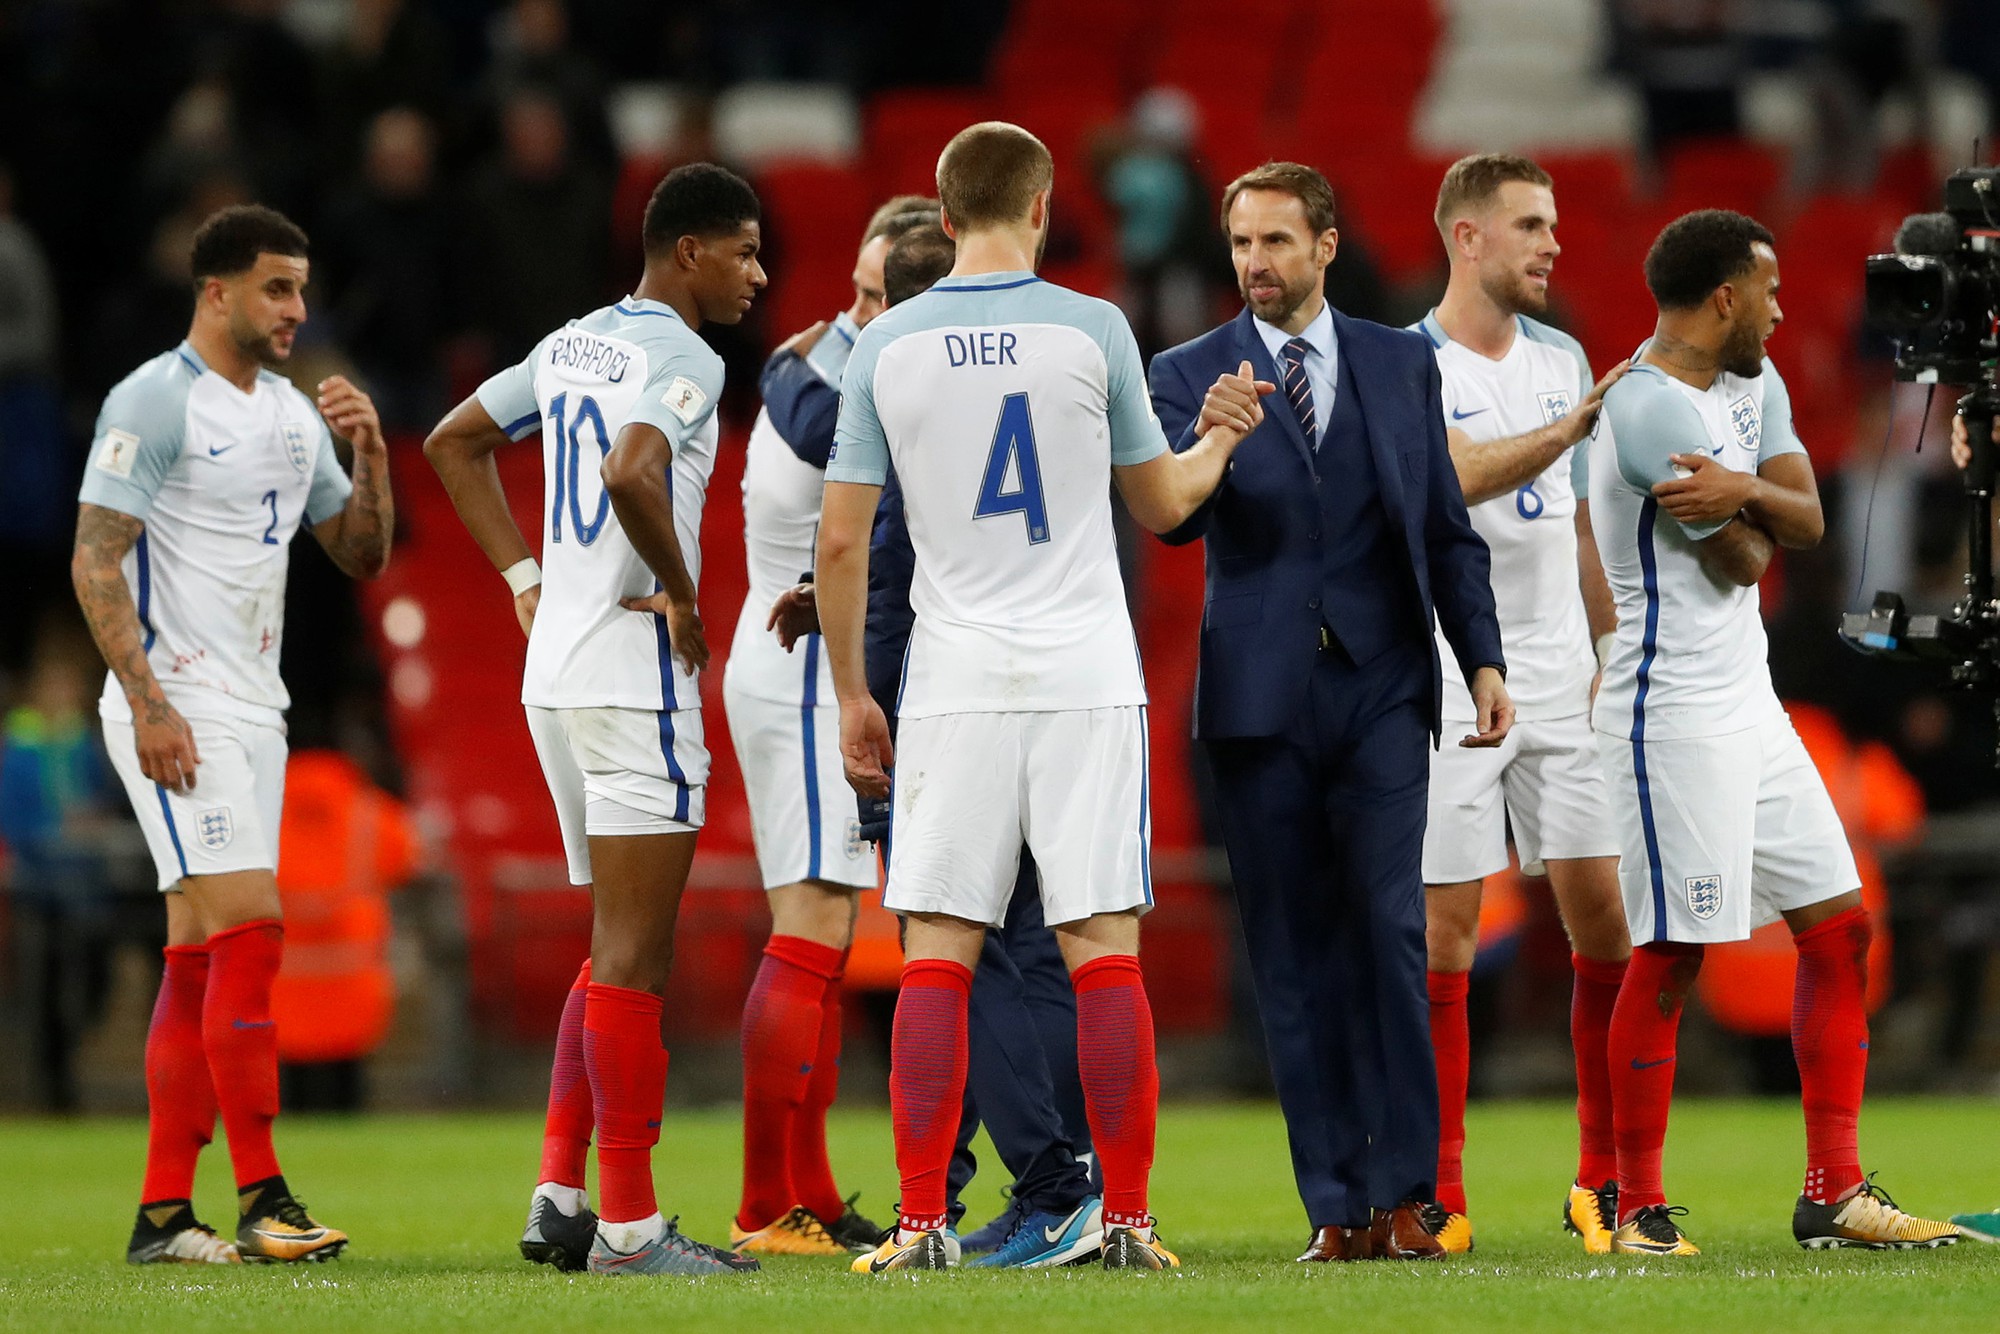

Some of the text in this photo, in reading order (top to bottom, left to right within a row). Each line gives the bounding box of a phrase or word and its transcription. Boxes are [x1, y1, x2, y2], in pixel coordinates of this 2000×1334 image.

[550, 336, 631, 383] RASHFORD
[944, 332, 1018, 367] DIER
[547, 390, 612, 547] 10
[972, 391, 1051, 546] 4
[261, 489, 279, 545] 2
